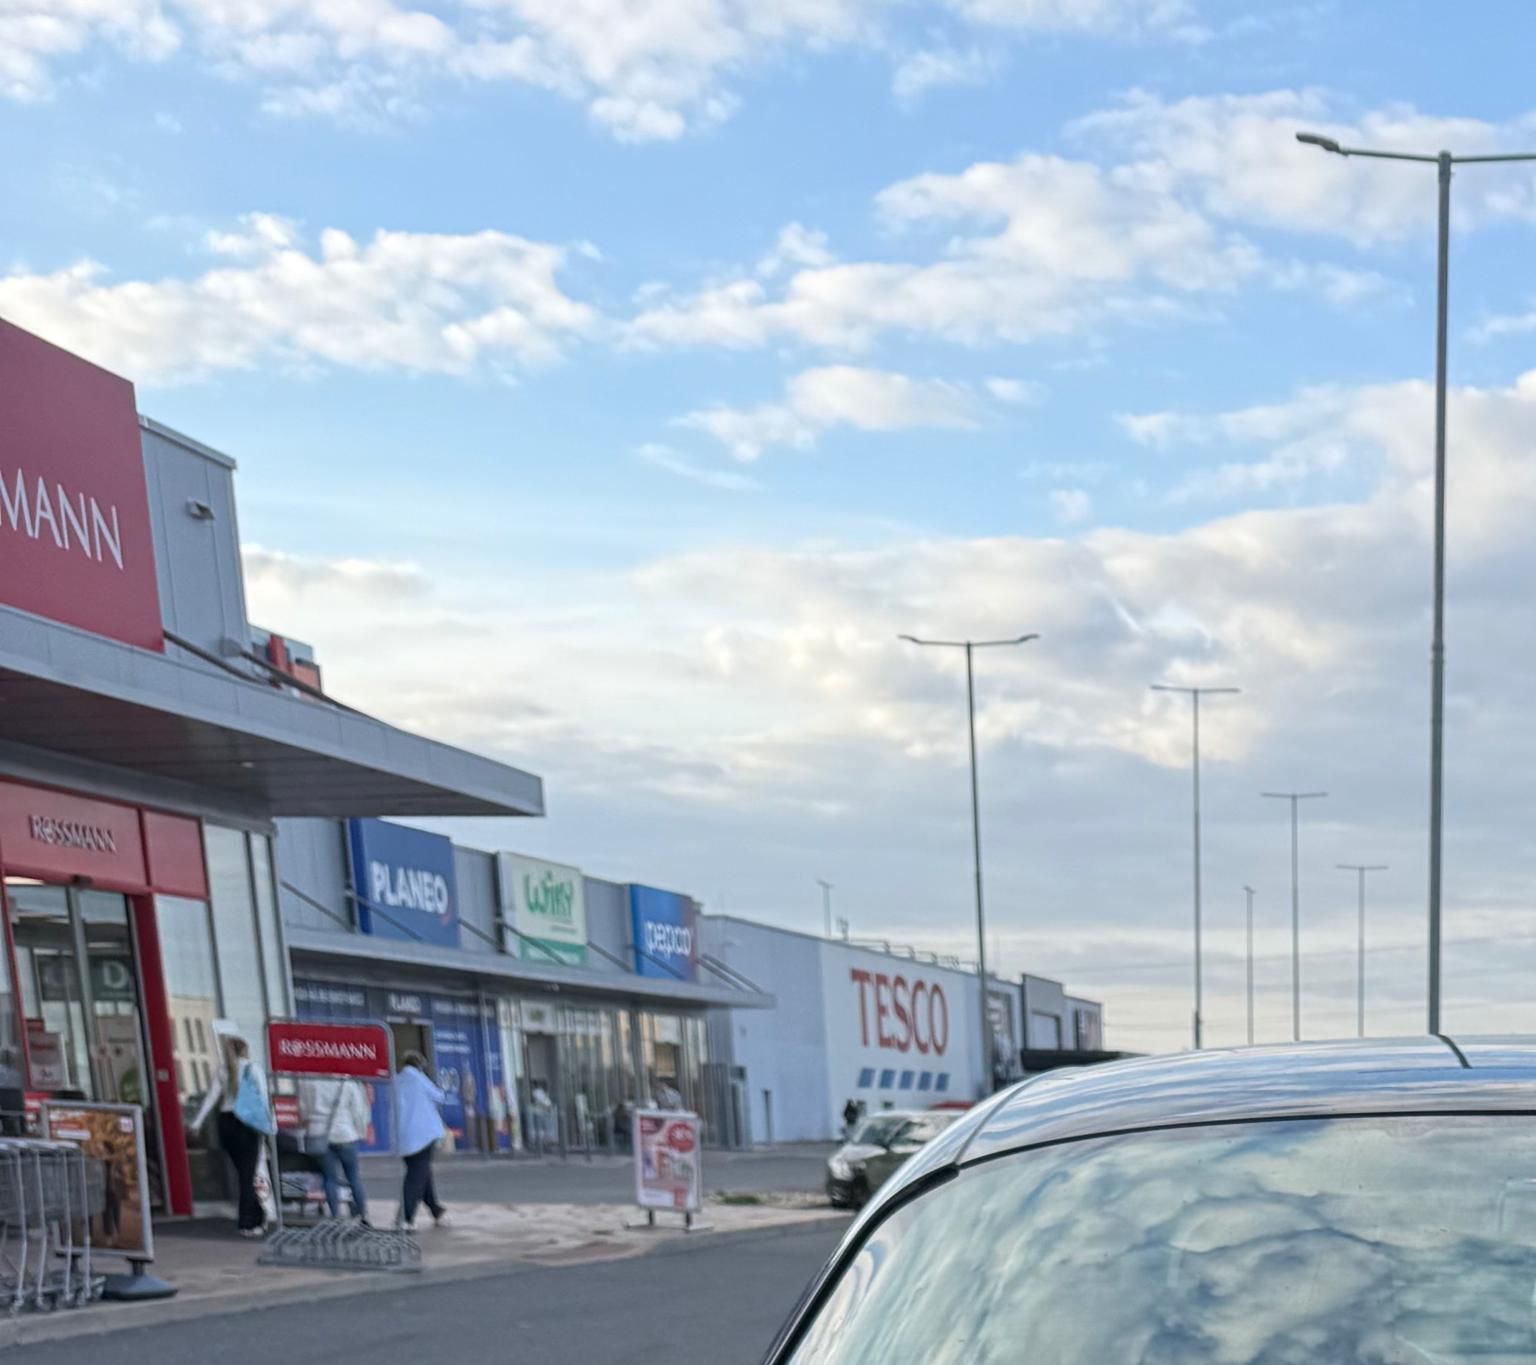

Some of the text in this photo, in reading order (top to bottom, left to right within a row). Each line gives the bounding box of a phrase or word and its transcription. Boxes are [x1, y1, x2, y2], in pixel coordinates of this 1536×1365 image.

[0, 467, 123, 570] MANN
[29, 815, 116, 852] ROSSMANN
[370, 861, 449, 914] PLANEO
[850, 968, 949, 1056] TESCO
[280, 1038, 377, 1060] ROSSMANN
